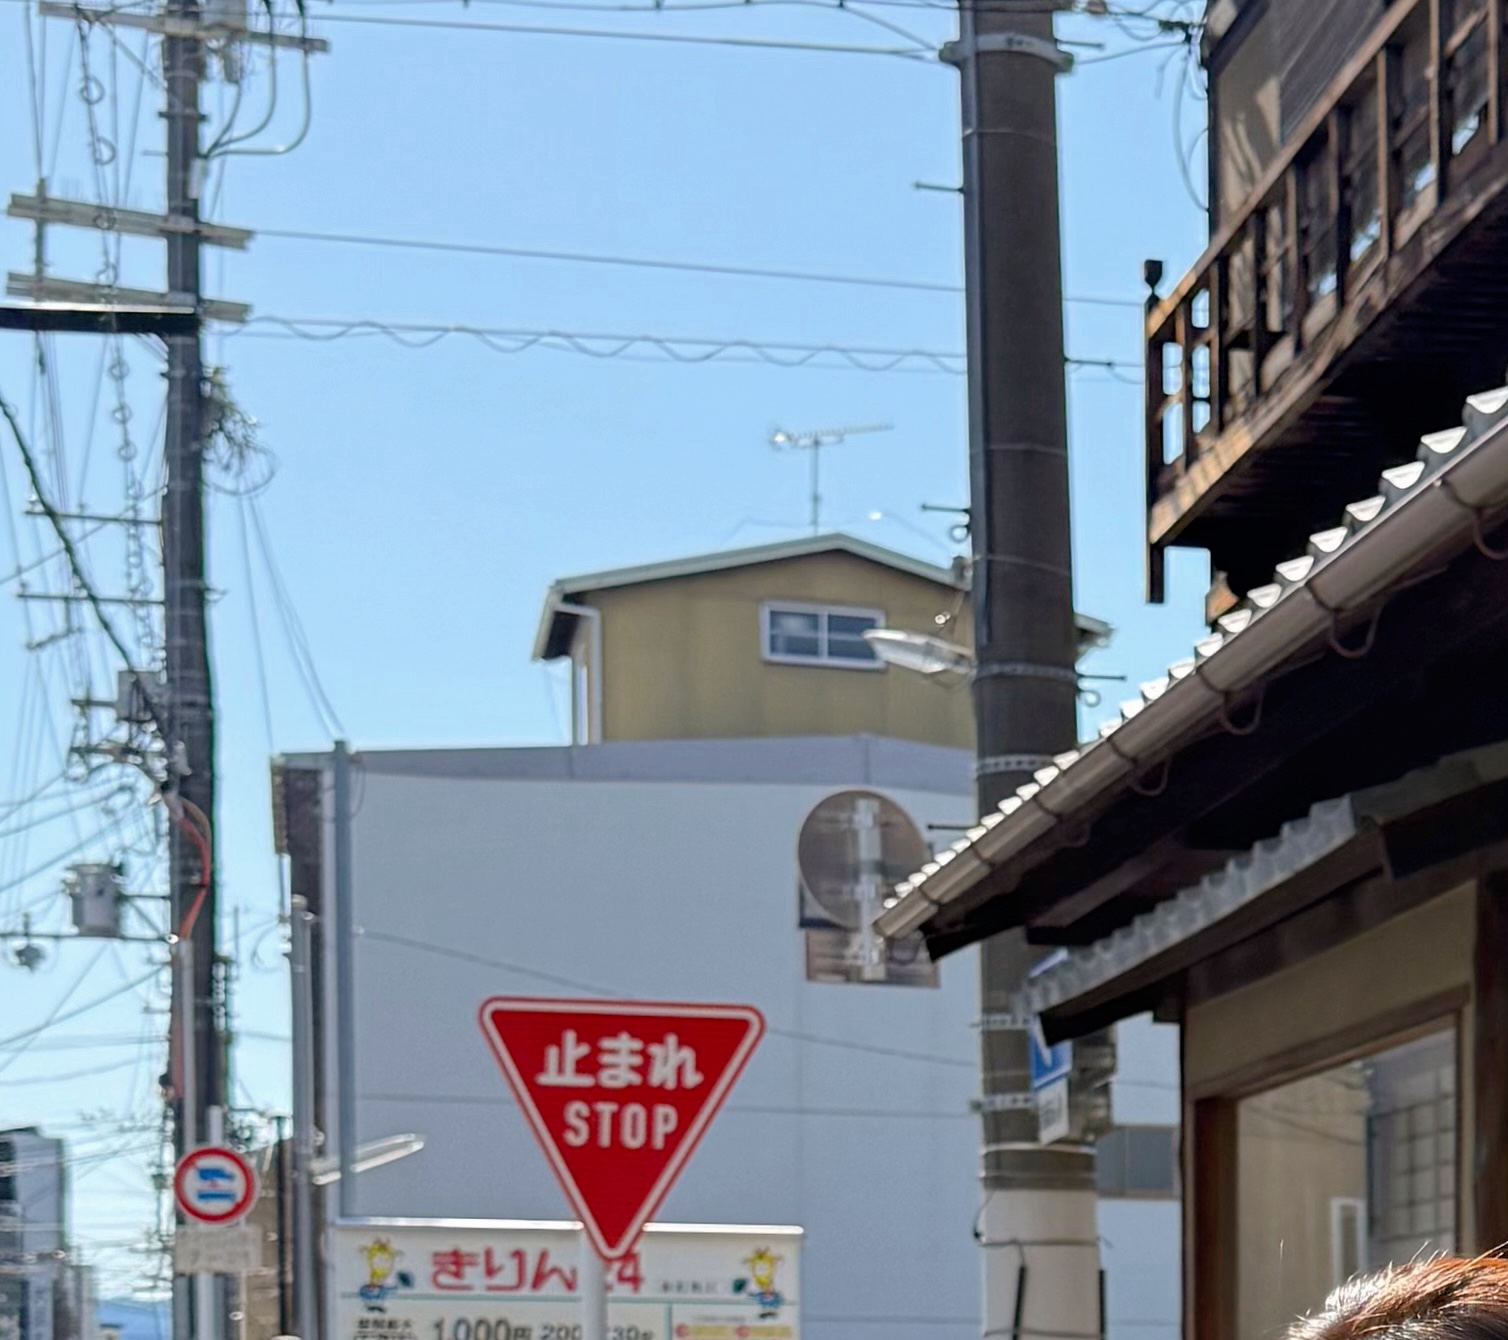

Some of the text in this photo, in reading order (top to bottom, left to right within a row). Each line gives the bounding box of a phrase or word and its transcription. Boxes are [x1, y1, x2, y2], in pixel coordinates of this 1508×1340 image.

[535, 1029, 704, 1090] 止まれ
[563, 1100, 678, 1150] STOP
[431, 1247, 578, 1293] きりん
